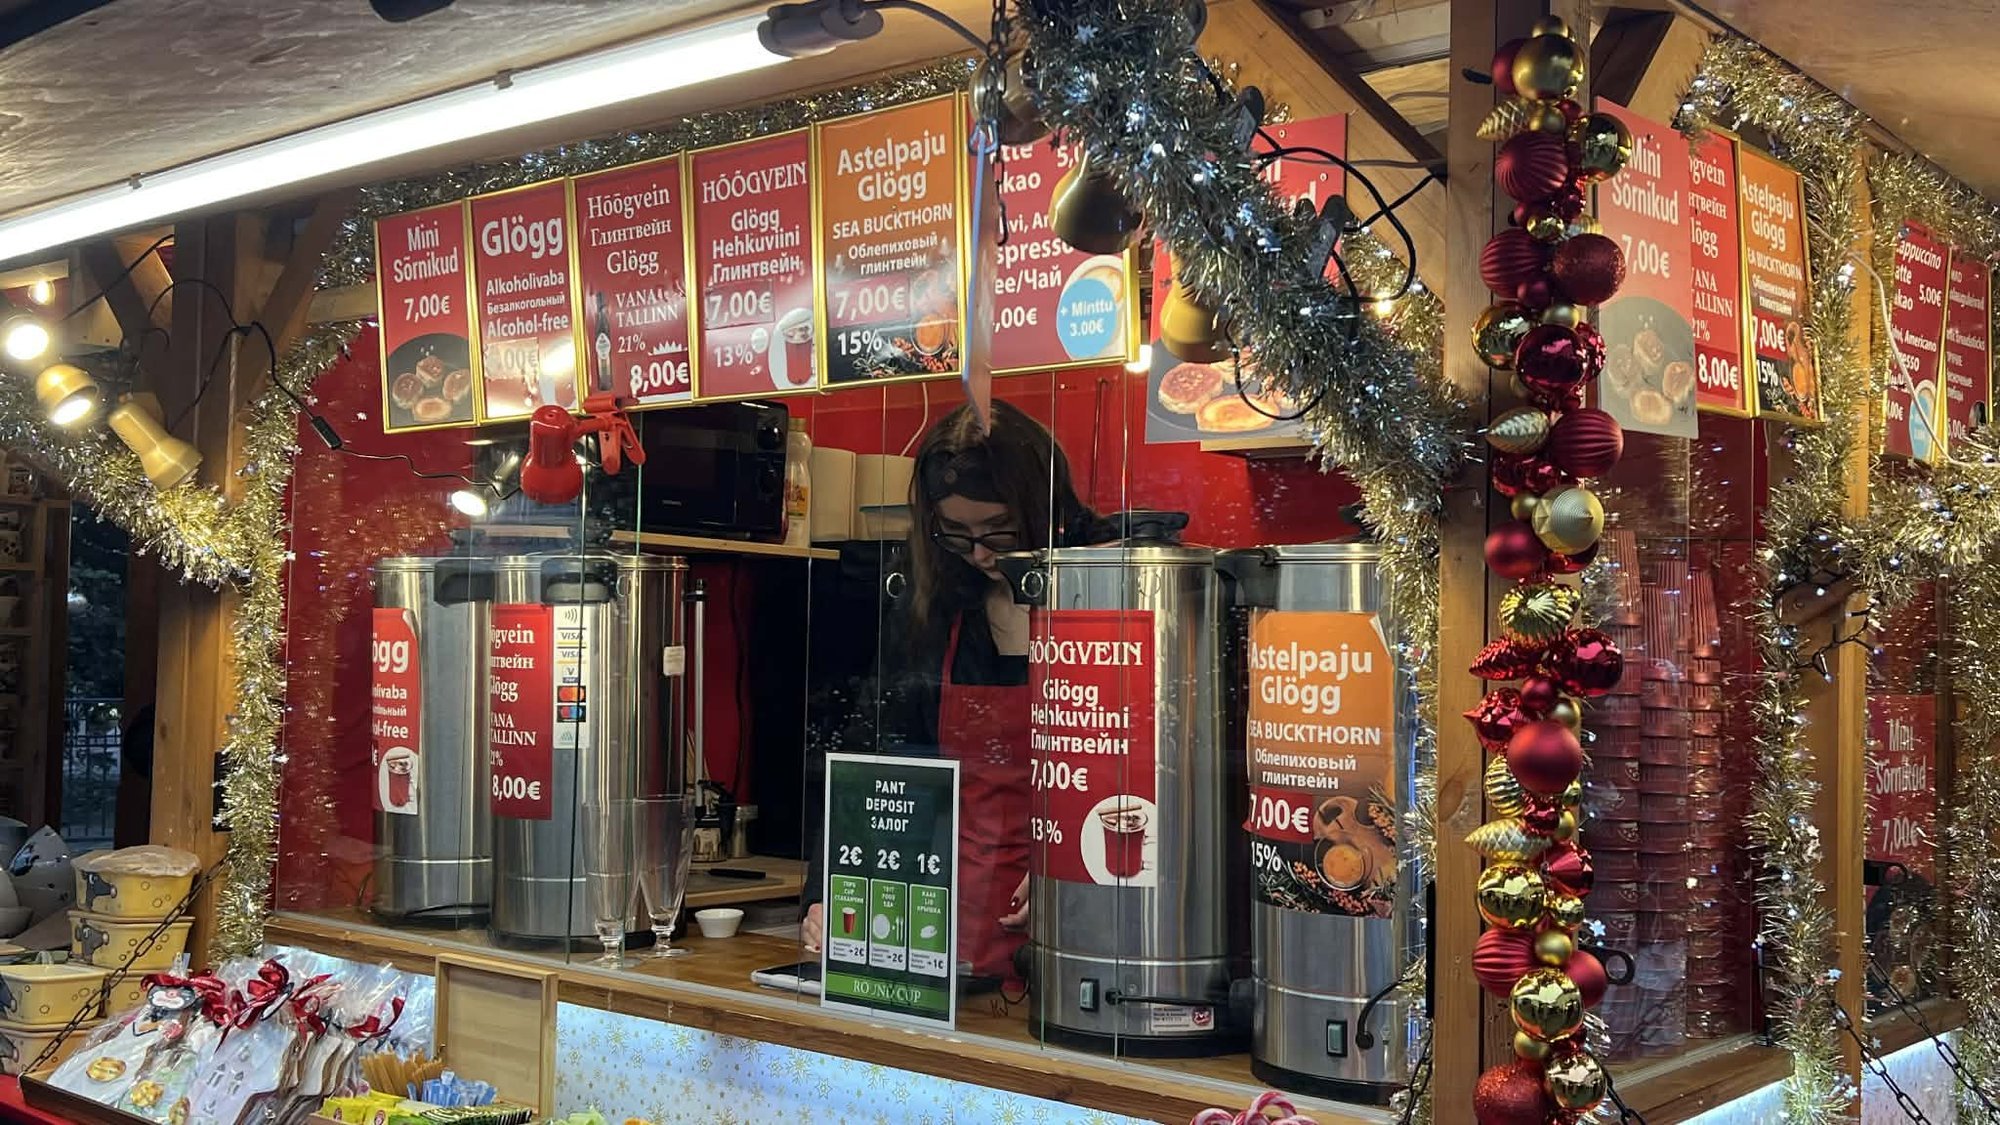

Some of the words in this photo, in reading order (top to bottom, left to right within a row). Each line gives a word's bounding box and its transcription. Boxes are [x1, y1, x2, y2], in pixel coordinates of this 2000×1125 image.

[837, 130, 946, 175] Astelpaju
[1628, 134, 1661, 179] Mini
[702, 161, 807, 203] HÕÕGVEIN
[858, 171, 927, 202] Glögg
[999, 171, 1042, 194] kao
[587, 184, 671, 219] Hõõgvein
[1611, 171, 1679, 225] Sõrnikud
[1741, 173, 1794, 224] Astelpaju
[590, 219, 672, 247] Глинтвейн
[731, 208, 780, 233] Glögg
[832, 222, 860, 240] SEA
[863, 203, 953, 235] BUCKTHORN
[1751, 210, 1786, 253] Glögg
[407, 220, 439, 251] Mini
[482, 214, 563, 259] Glögg
[712, 225, 800, 259] Hehkuviini
[848, 232, 938, 259] Облепиховый
[394, 247, 458, 284] Sõrnikud
[607, 249, 659, 276] Glögg
[712, 254, 800, 284] Глинтвейн
[860, 254, 927, 276] глинтвейн
[1621, 235, 1671, 279] 7,00€
[1896, 240, 1942, 270] appuccino
[486, 270, 565, 296] Alkoholivaba
[995, 266, 1063, 295] ee/Чай
[404, 295, 450, 323] 7,00€
[487, 292, 566, 315] Безалкогольный
[615, 288, 656, 308] VANA
[710, 291, 772, 321] 7,00€
[835, 285, 905, 321] 7,00€
[1071, 299, 1114, 318] Minttu
[1919, 283, 1942, 307] 5,00€
[487, 313, 568, 337] Alcohol-free
[616, 305, 678, 328] TALLINN
[993, 306, 1038, 333] ,00€
[1069, 319, 1105, 338] 3.00€
[617, 334, 646, 353] 21%
[837, 328, 882, 356] 15%
[714, 345, 752, 368] 13%
[630, 360, 690, 392] 8,00€
[1698, 353, 1739, 390] 8,00€
[1251, 641, 1373, 682] Astelpaju
[1042, 679, 1099, 707] Glögg
[1261, 675, 1342, 715] Glögg
[1031, 703, 1129, 729] Hehkuviini
[1031, 728, 1129, 755] Глинтвейн
[1265, 720, 1381, 745] BUCKTHORN
[1255, 748, 1357, 771] Облепиховый
[492, 775, 541, 800] 8,00€
[875, 780, 906, 795] PANT
[1030, 759, 1088, 792] 7,00€
[1262, 770, 1339, 790] глинтвейн
[866, 798, 915, 815] DEPOSIT
[871, 816, 909, 832] ЗАЛОГ
[1031, 817, 1063, 845] 13%
[839, 845, 863, 867] 2€
[877, 849, 900, 871] 2€
[917, 853, 941, 875] 1€
[1251, 841, 1281, 872] 15%
